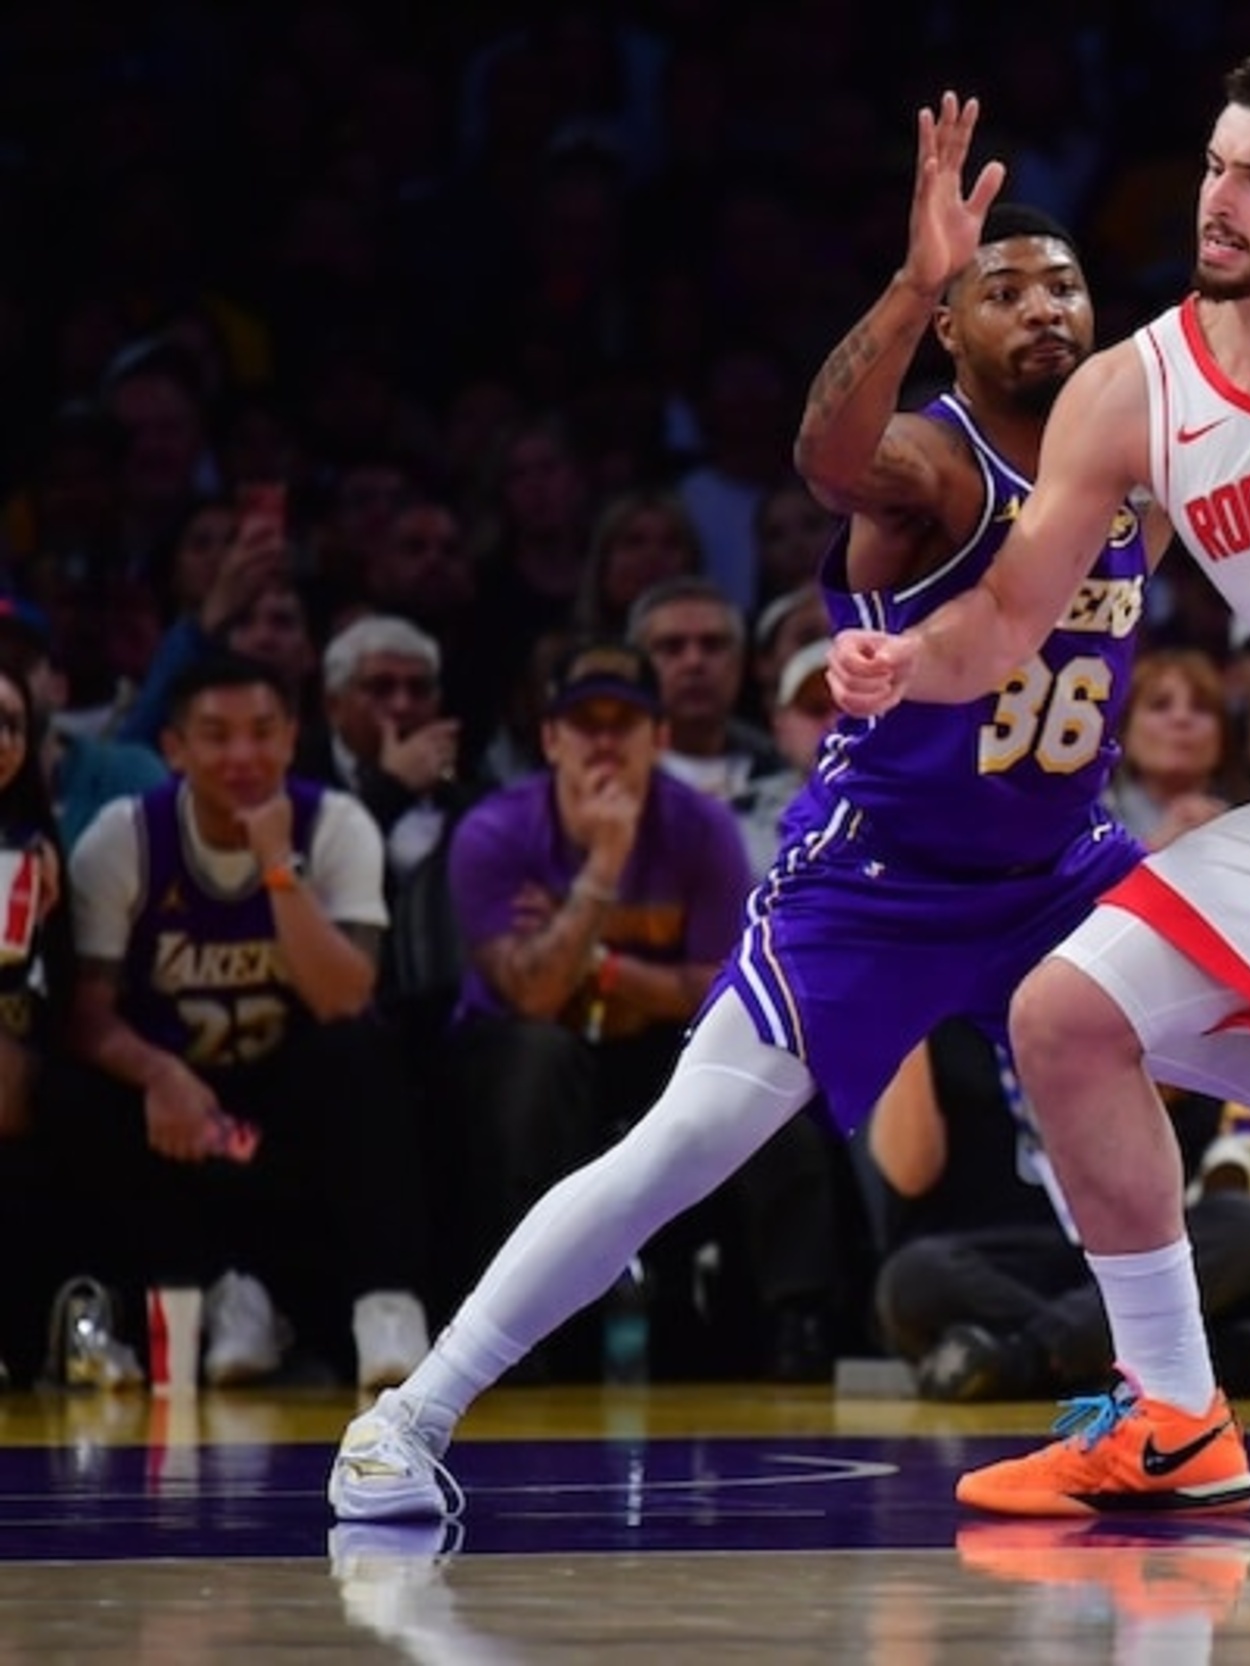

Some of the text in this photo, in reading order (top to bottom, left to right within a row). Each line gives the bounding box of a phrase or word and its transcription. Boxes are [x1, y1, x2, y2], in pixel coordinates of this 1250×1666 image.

[1058, 574, 1143, 638] ERS
[978, 652, 1113, 774] 36
[152, 930, 288, 1000] LAKER
